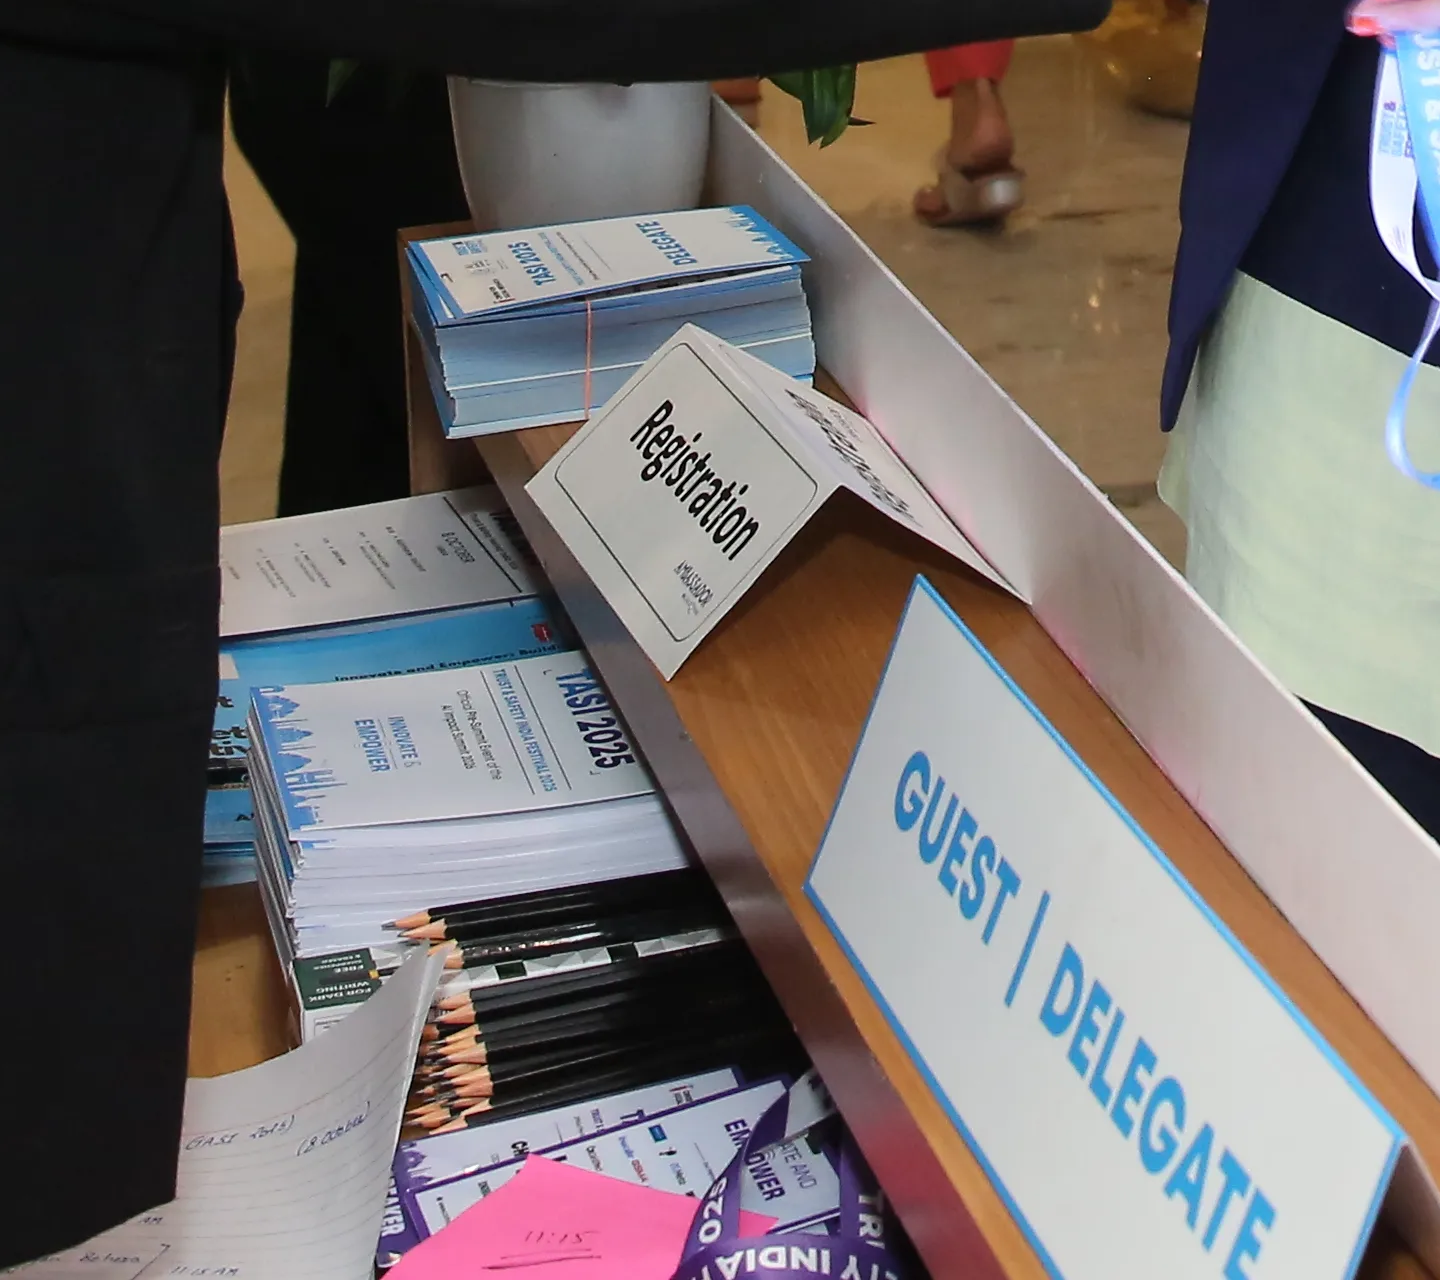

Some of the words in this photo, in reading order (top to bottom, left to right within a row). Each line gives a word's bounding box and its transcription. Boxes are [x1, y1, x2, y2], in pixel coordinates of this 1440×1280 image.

[507, 241, 542, 265] 2025
[635, 220, 698, 267] DELEGATE
[523, 262, 558, 287] TASI
[629, 399, 760, 561] Registration
[493, 668, 514, 689] TRUST
[555, 667, 611, 716] TASI
[443, 711, 462, 733] Impact
[504, 695, 528, 720] SAFETY
[354, 719, 390, 772] EMPOWER
[388, 716, 418, 759] INNOVATE
[451, 733, 472, 756] Summit
[465, 711, 488, 745] Pre-Summit
[479, 745, 496, 762] Event
[515, 721, 537, 742] INDIA
[576, 716, 636, 769] 2025
[524, 743, 552, 776] FESTIVAL
[308, 991, 345, 1002] DARK
[315, 981, 370, 993] WRITING
[346, 987, 372, 996] FOR
[894, 750, 1022, 946] GUEST
[1039, 942, 1277, 1280] DELEGATE
[715, 1246, 831, 1280] INDIA
